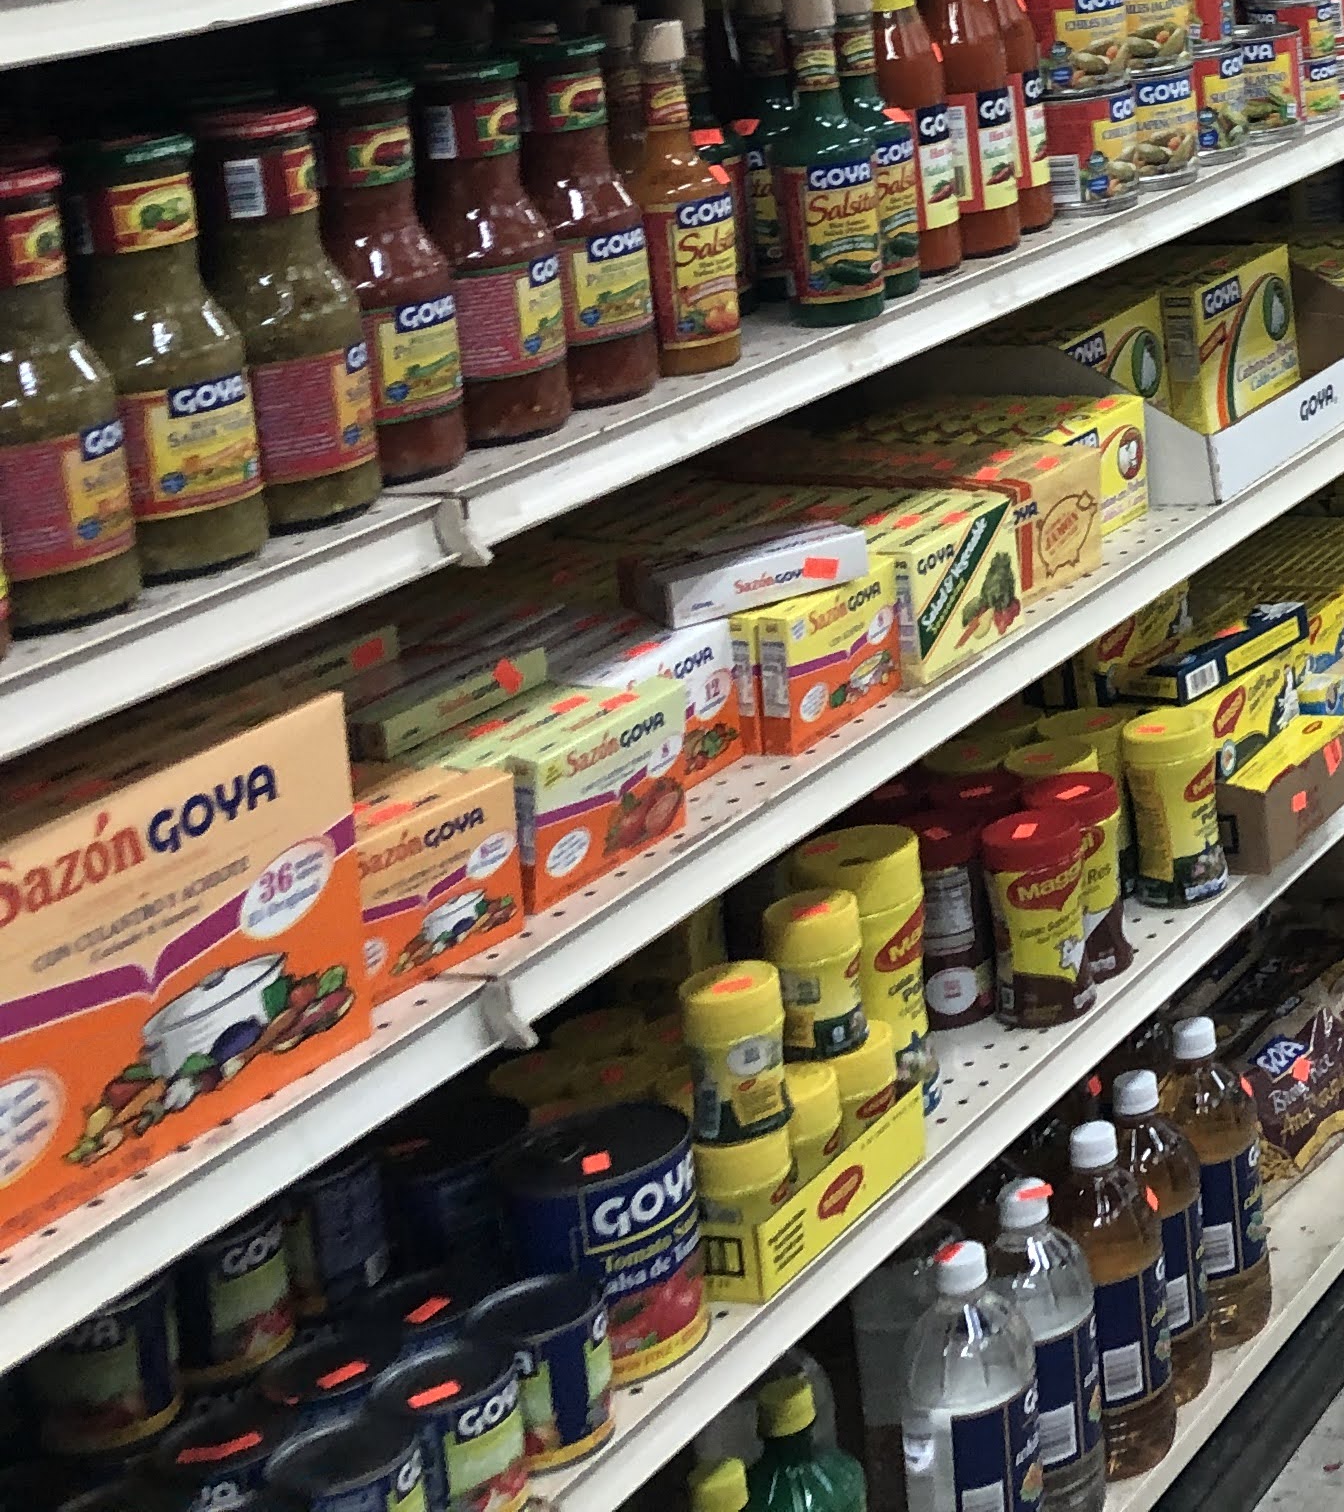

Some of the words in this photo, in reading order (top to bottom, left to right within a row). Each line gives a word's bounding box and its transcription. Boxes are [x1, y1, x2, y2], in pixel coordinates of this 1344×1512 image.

[1026, 79, 1044, 98] GO
[1139, 79, 1190, 104] GOYA
[920, 114, 947, 137] GO
[1113, 99, 1135, 120] GO
[810, 162, 871, 188] GOYA
[531, 258, 559, 284] GO
[1204, 279, 1240, 315] GOYA
[1300, 385, 1335, 421] GOYA
[84, 424, 123, 455] GO
[774, 567, 804, 584] GOY
[917, 543, 954, 576] GOYA
[847, 580, 882, 612] GOYA
[674, 646, 715, 679] GOYA
[620, 712, 665, 748] GOYA
[147, 764, 279, 853] GOYA
[423, 807, 485, 848] GOYA
[258, 861, 295, 903] 36
[606, 1235, 674, 1273] Tomato
[606, 1268, 647, 1295] alsa
